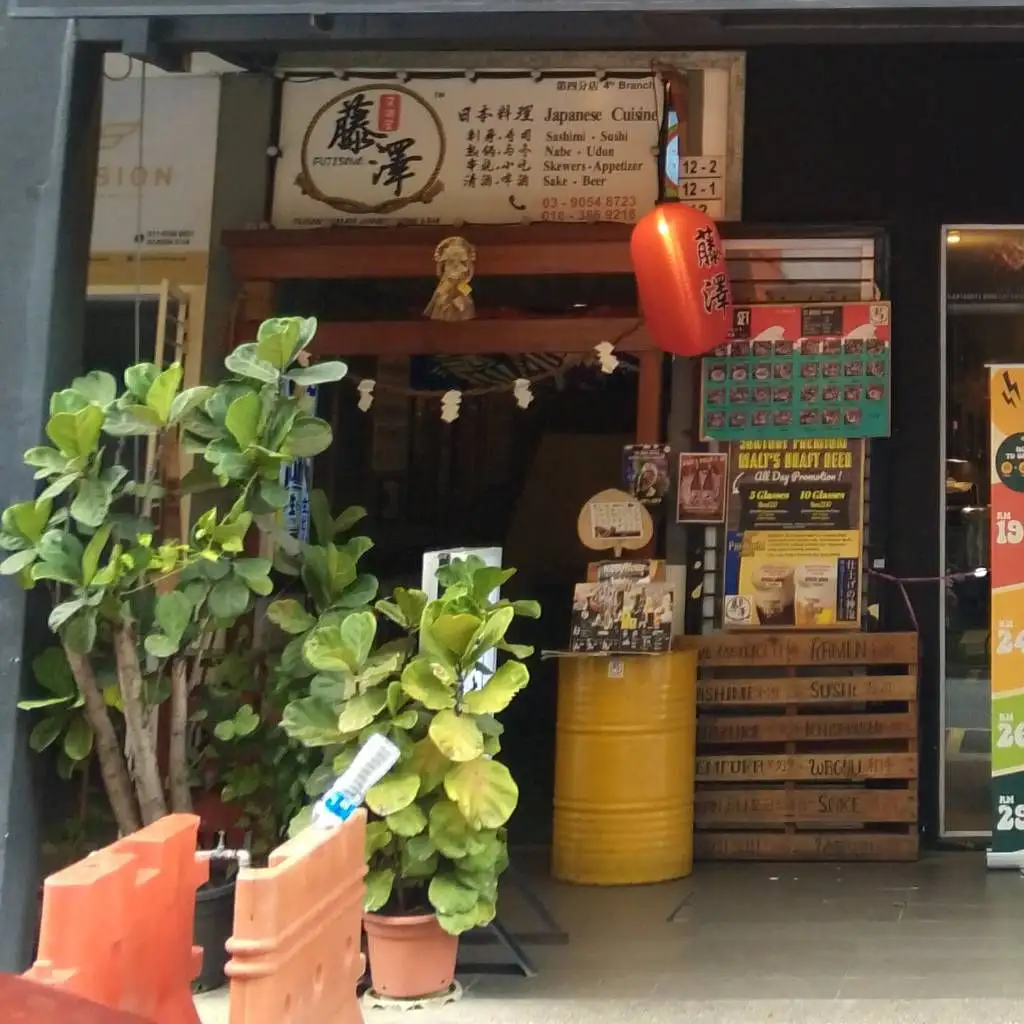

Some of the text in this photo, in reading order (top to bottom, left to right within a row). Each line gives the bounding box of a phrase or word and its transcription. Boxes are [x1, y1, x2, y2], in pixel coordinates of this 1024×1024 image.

[618, 80, 655, 90] Branch
[457, 103, 534, 123] 日本料理
[543, 107, 602, 126] Japanese
[545, 129, 586, 142] Sashimi
[600, 129, 628, 142] Sushi
[587, 145, 615, 157] Udon
[543, 175, 568, 187] Sake
[582, 175, 607, 187] Beer
